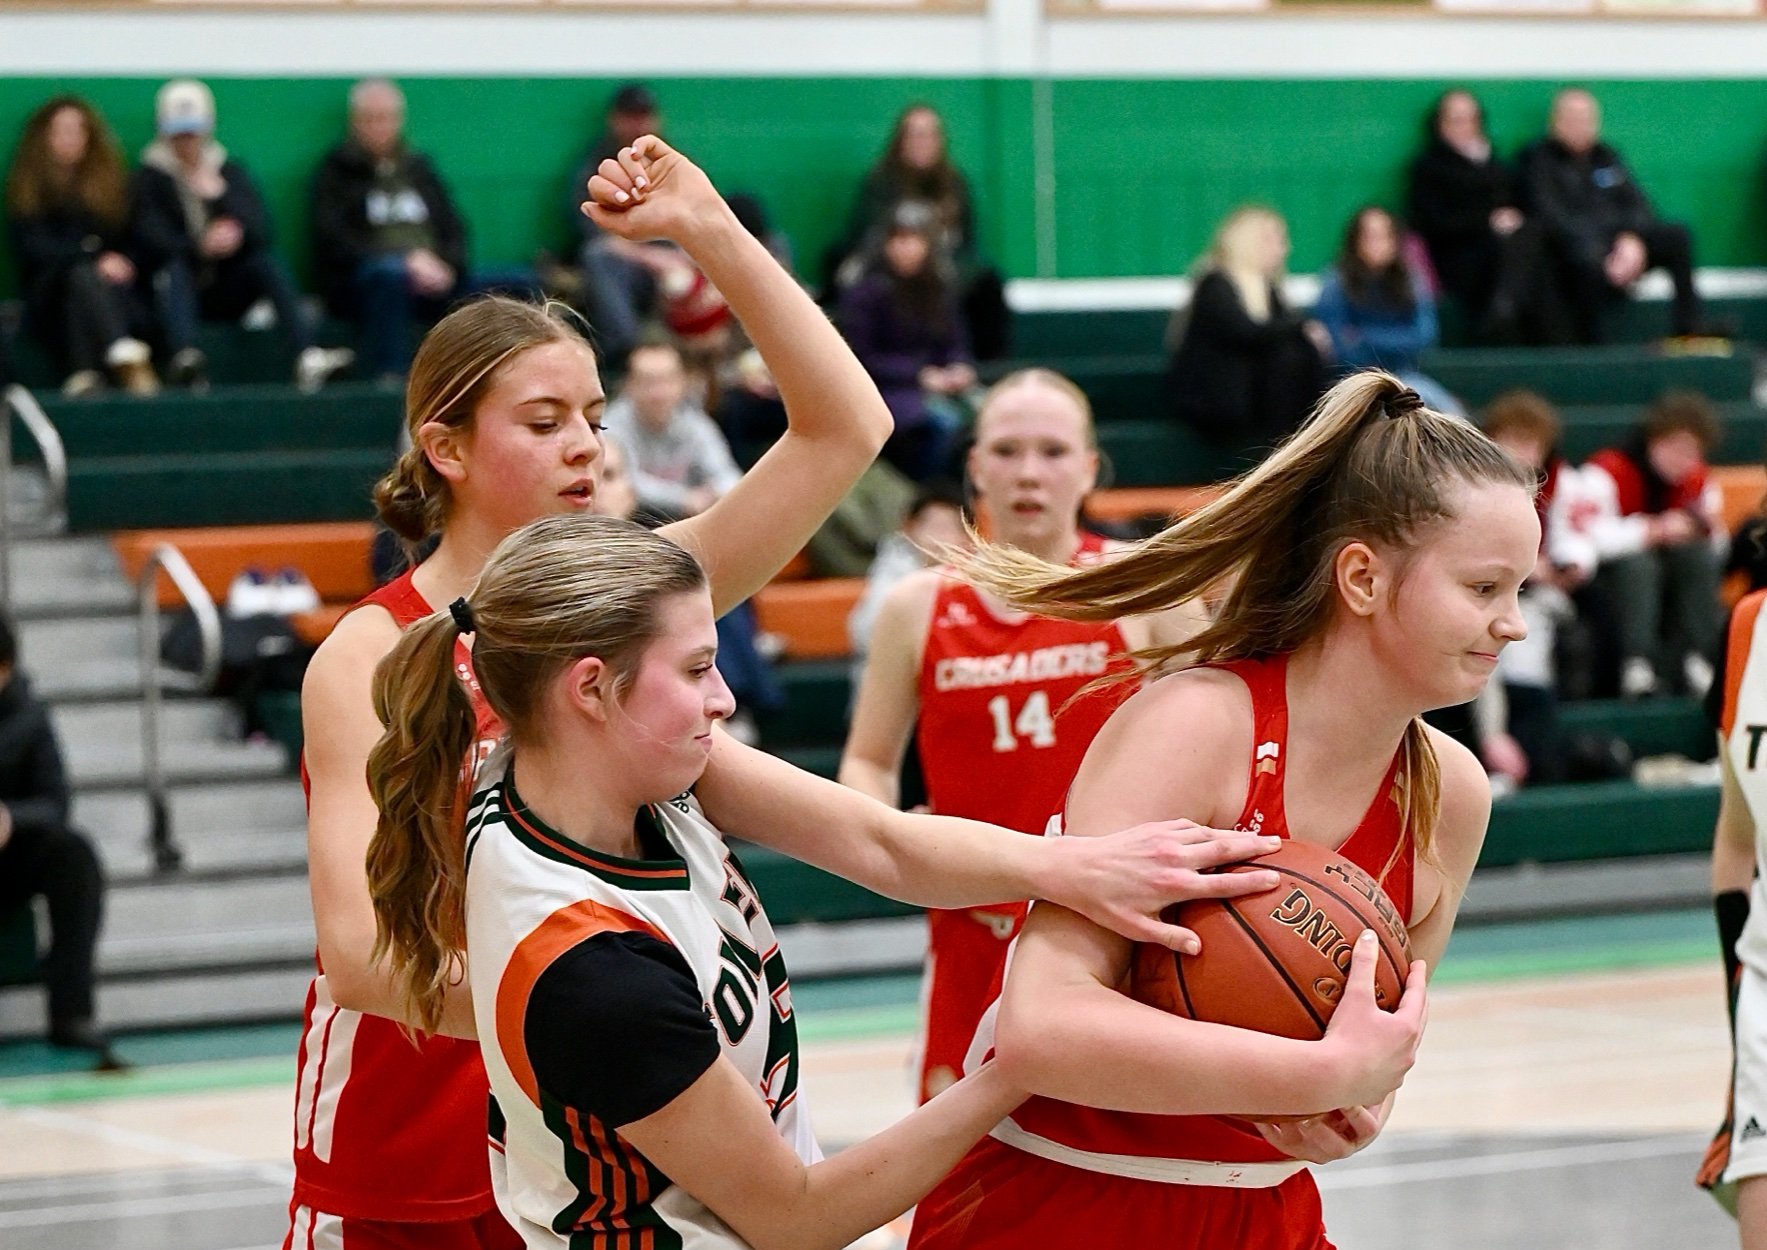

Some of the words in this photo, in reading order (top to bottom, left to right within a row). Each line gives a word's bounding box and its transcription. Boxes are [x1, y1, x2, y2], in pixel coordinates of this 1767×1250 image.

[934, 640, 1110, 693] CRUSADERS
[987, 689, 1057, 752] 14
[1269, 888, 1354, 978] DING
